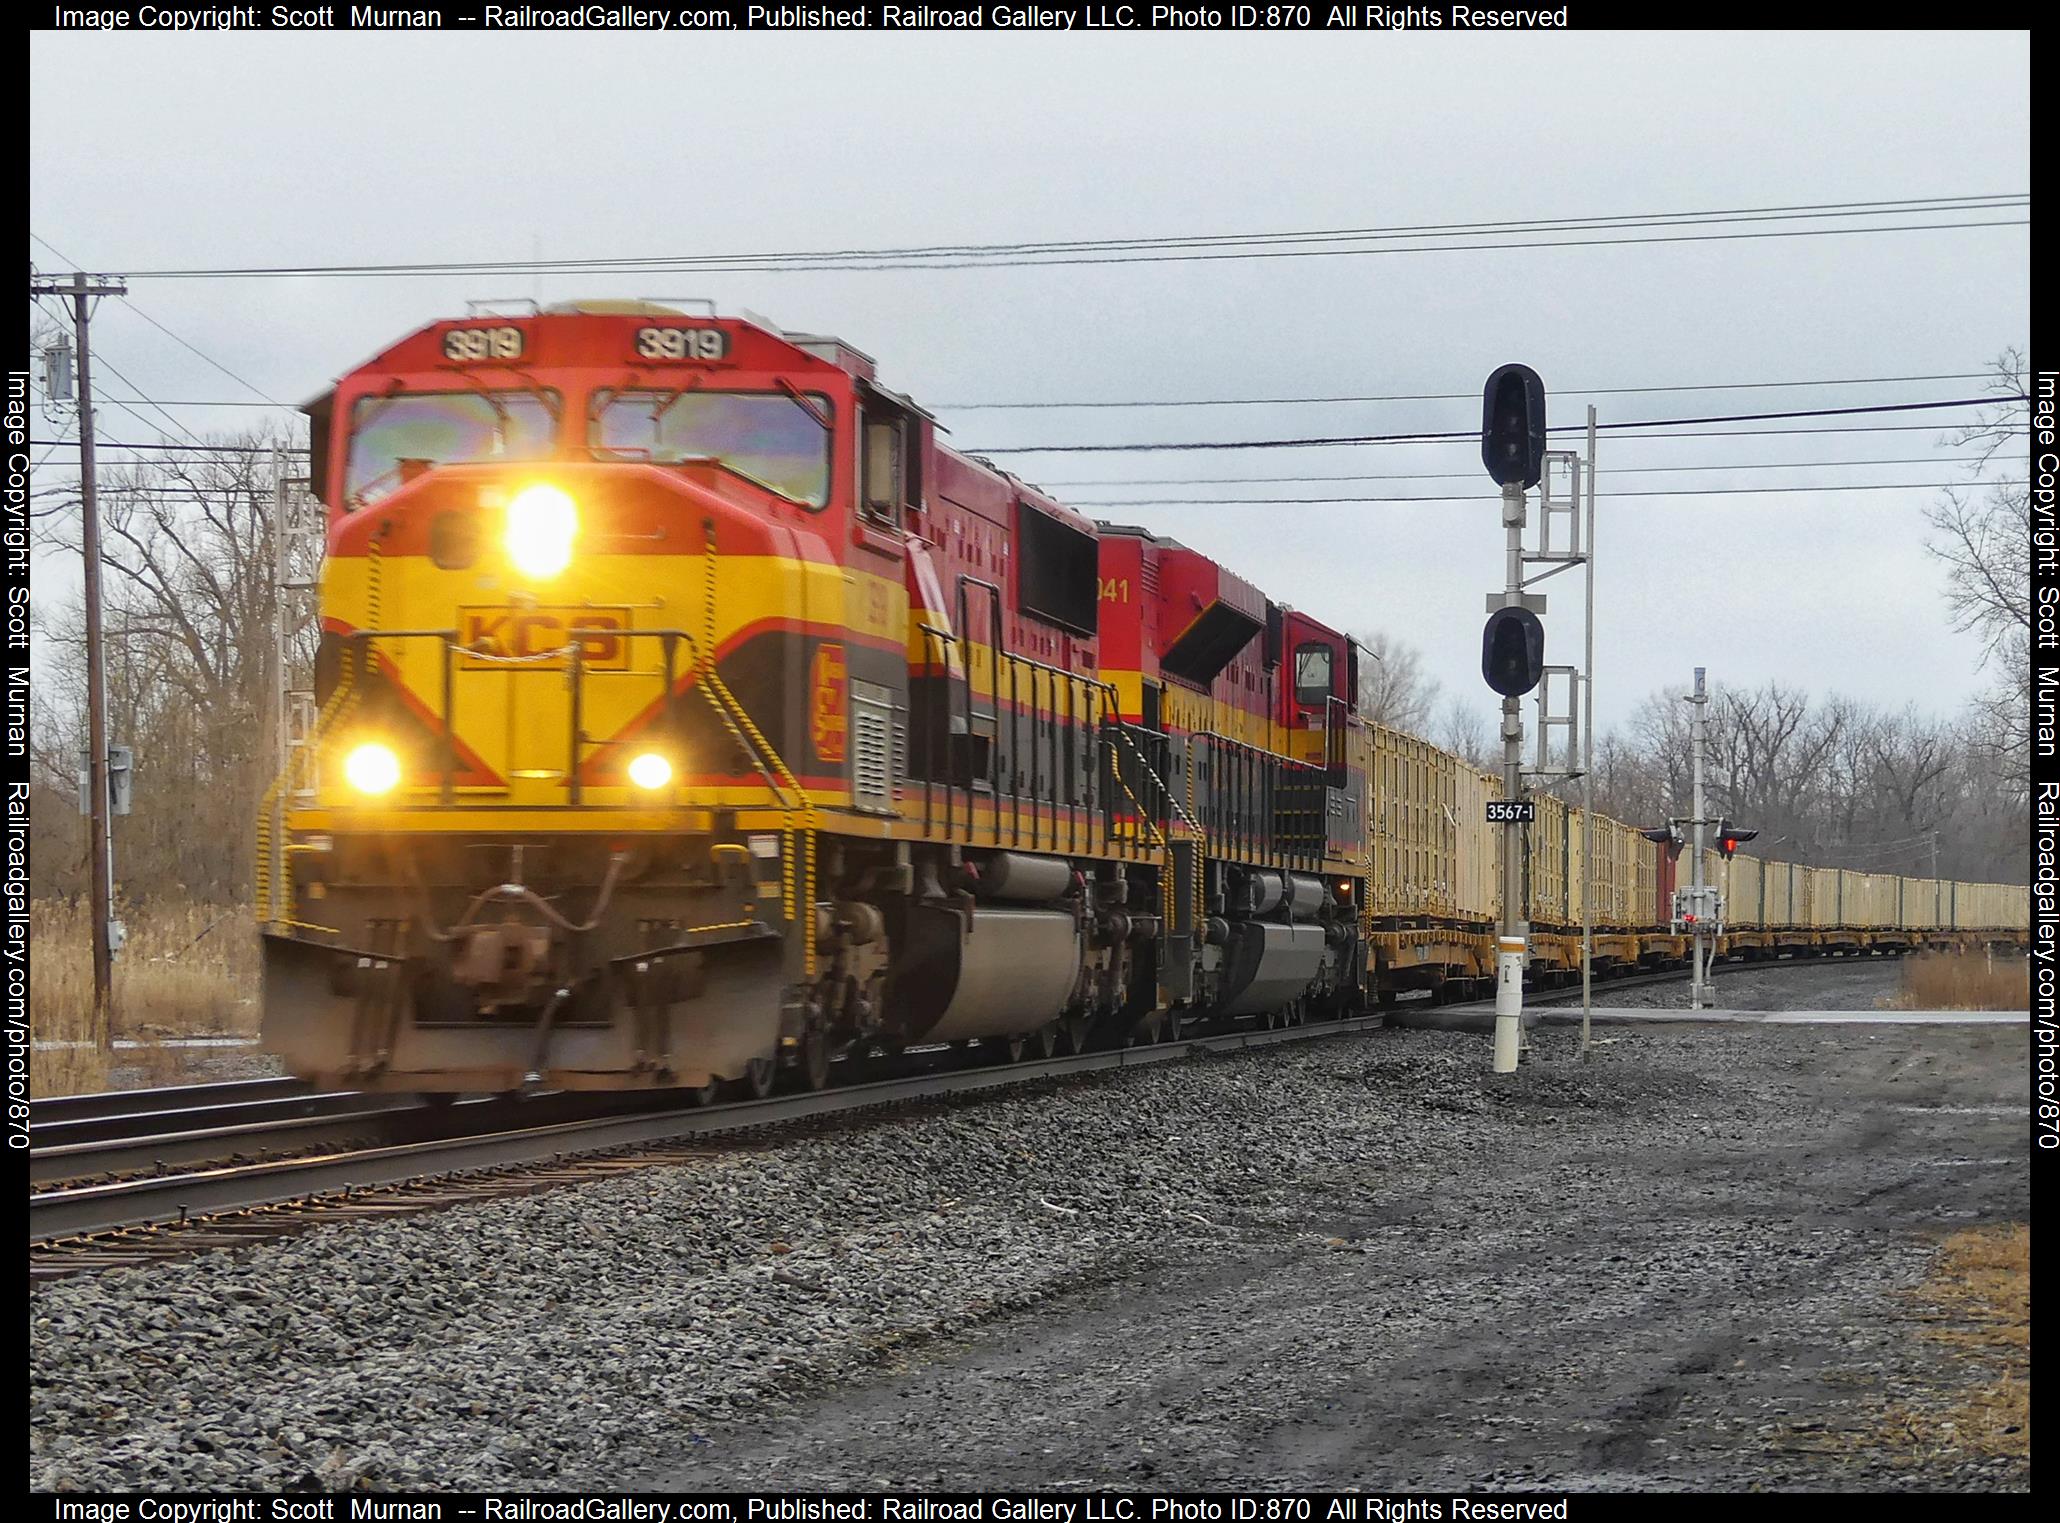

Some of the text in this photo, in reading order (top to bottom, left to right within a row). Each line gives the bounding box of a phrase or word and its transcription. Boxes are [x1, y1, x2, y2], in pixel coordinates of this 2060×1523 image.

[446, 327, 520, 361] 3919
[638, 328, 724, 361] 3919
[1487, 804, 1533, 819] 3567-1
